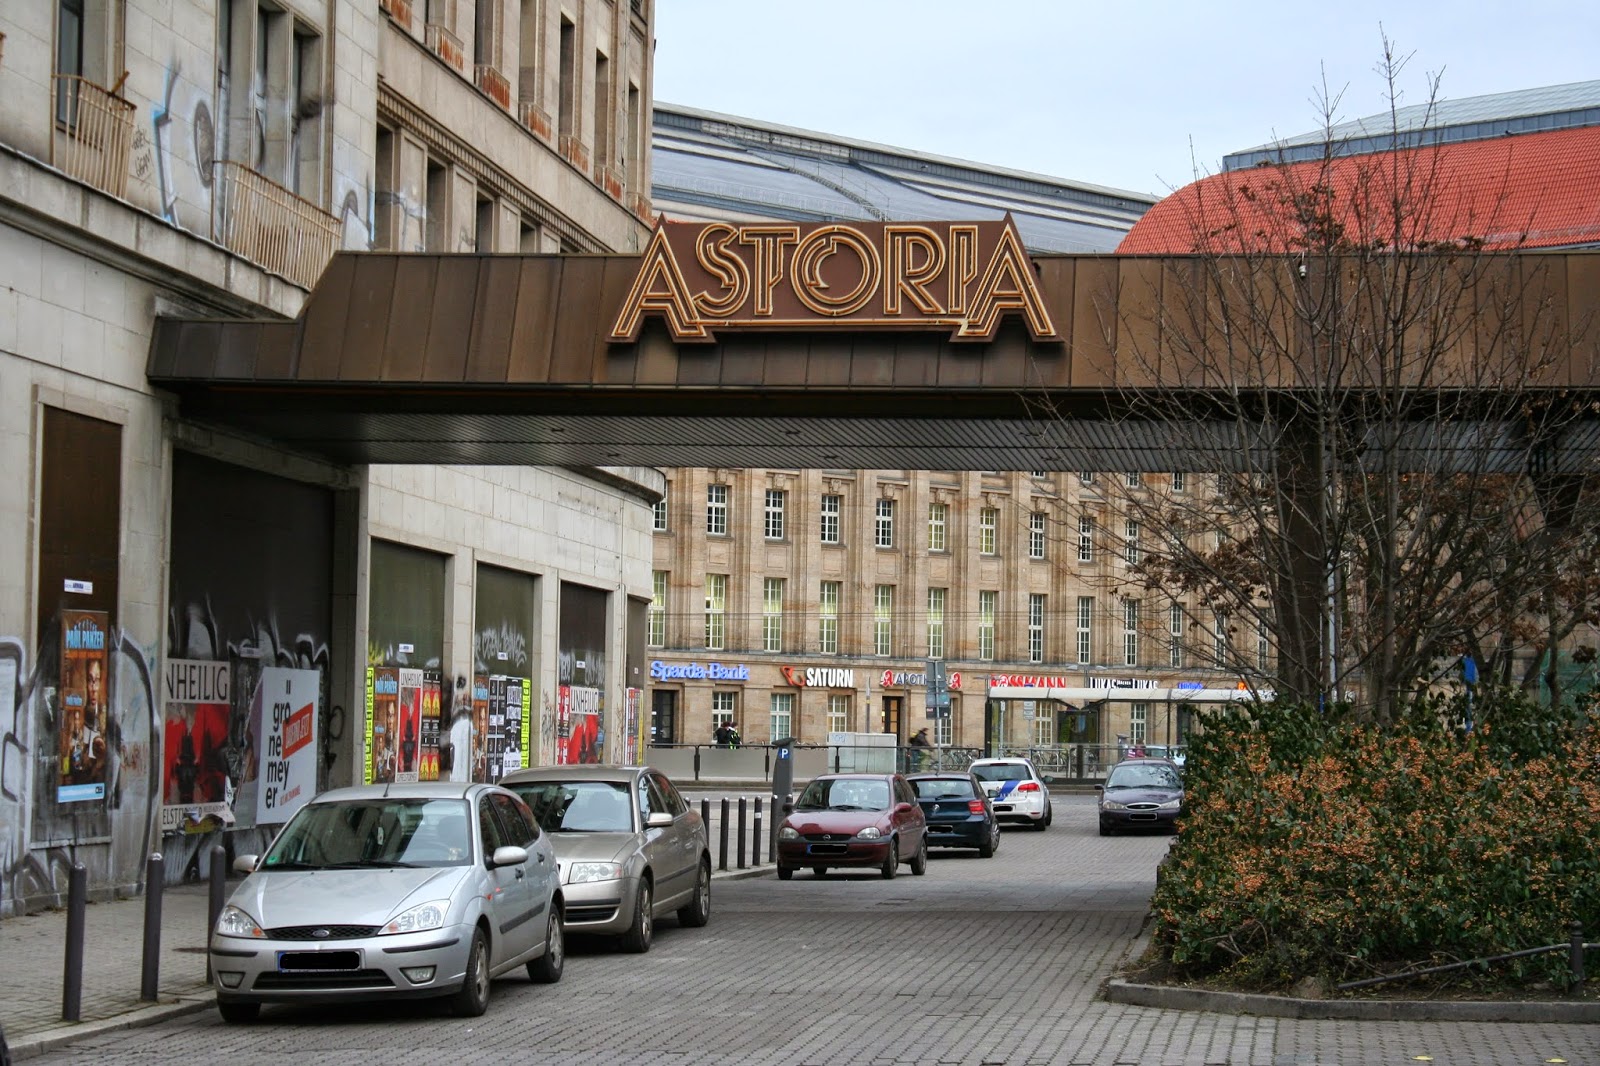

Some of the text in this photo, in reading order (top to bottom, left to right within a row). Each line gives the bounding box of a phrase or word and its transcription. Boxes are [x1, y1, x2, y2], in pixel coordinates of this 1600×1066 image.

[610, 222, 1058, 338] ASTORIA
[166, 664, 227, 700] NHEILIG
[650, 660, 750, 682] Sparda-Bank
[806, 667, 854, 688] SATURN
[781, 748, 789, 759] P
[267, 761, 290, 790] mey
